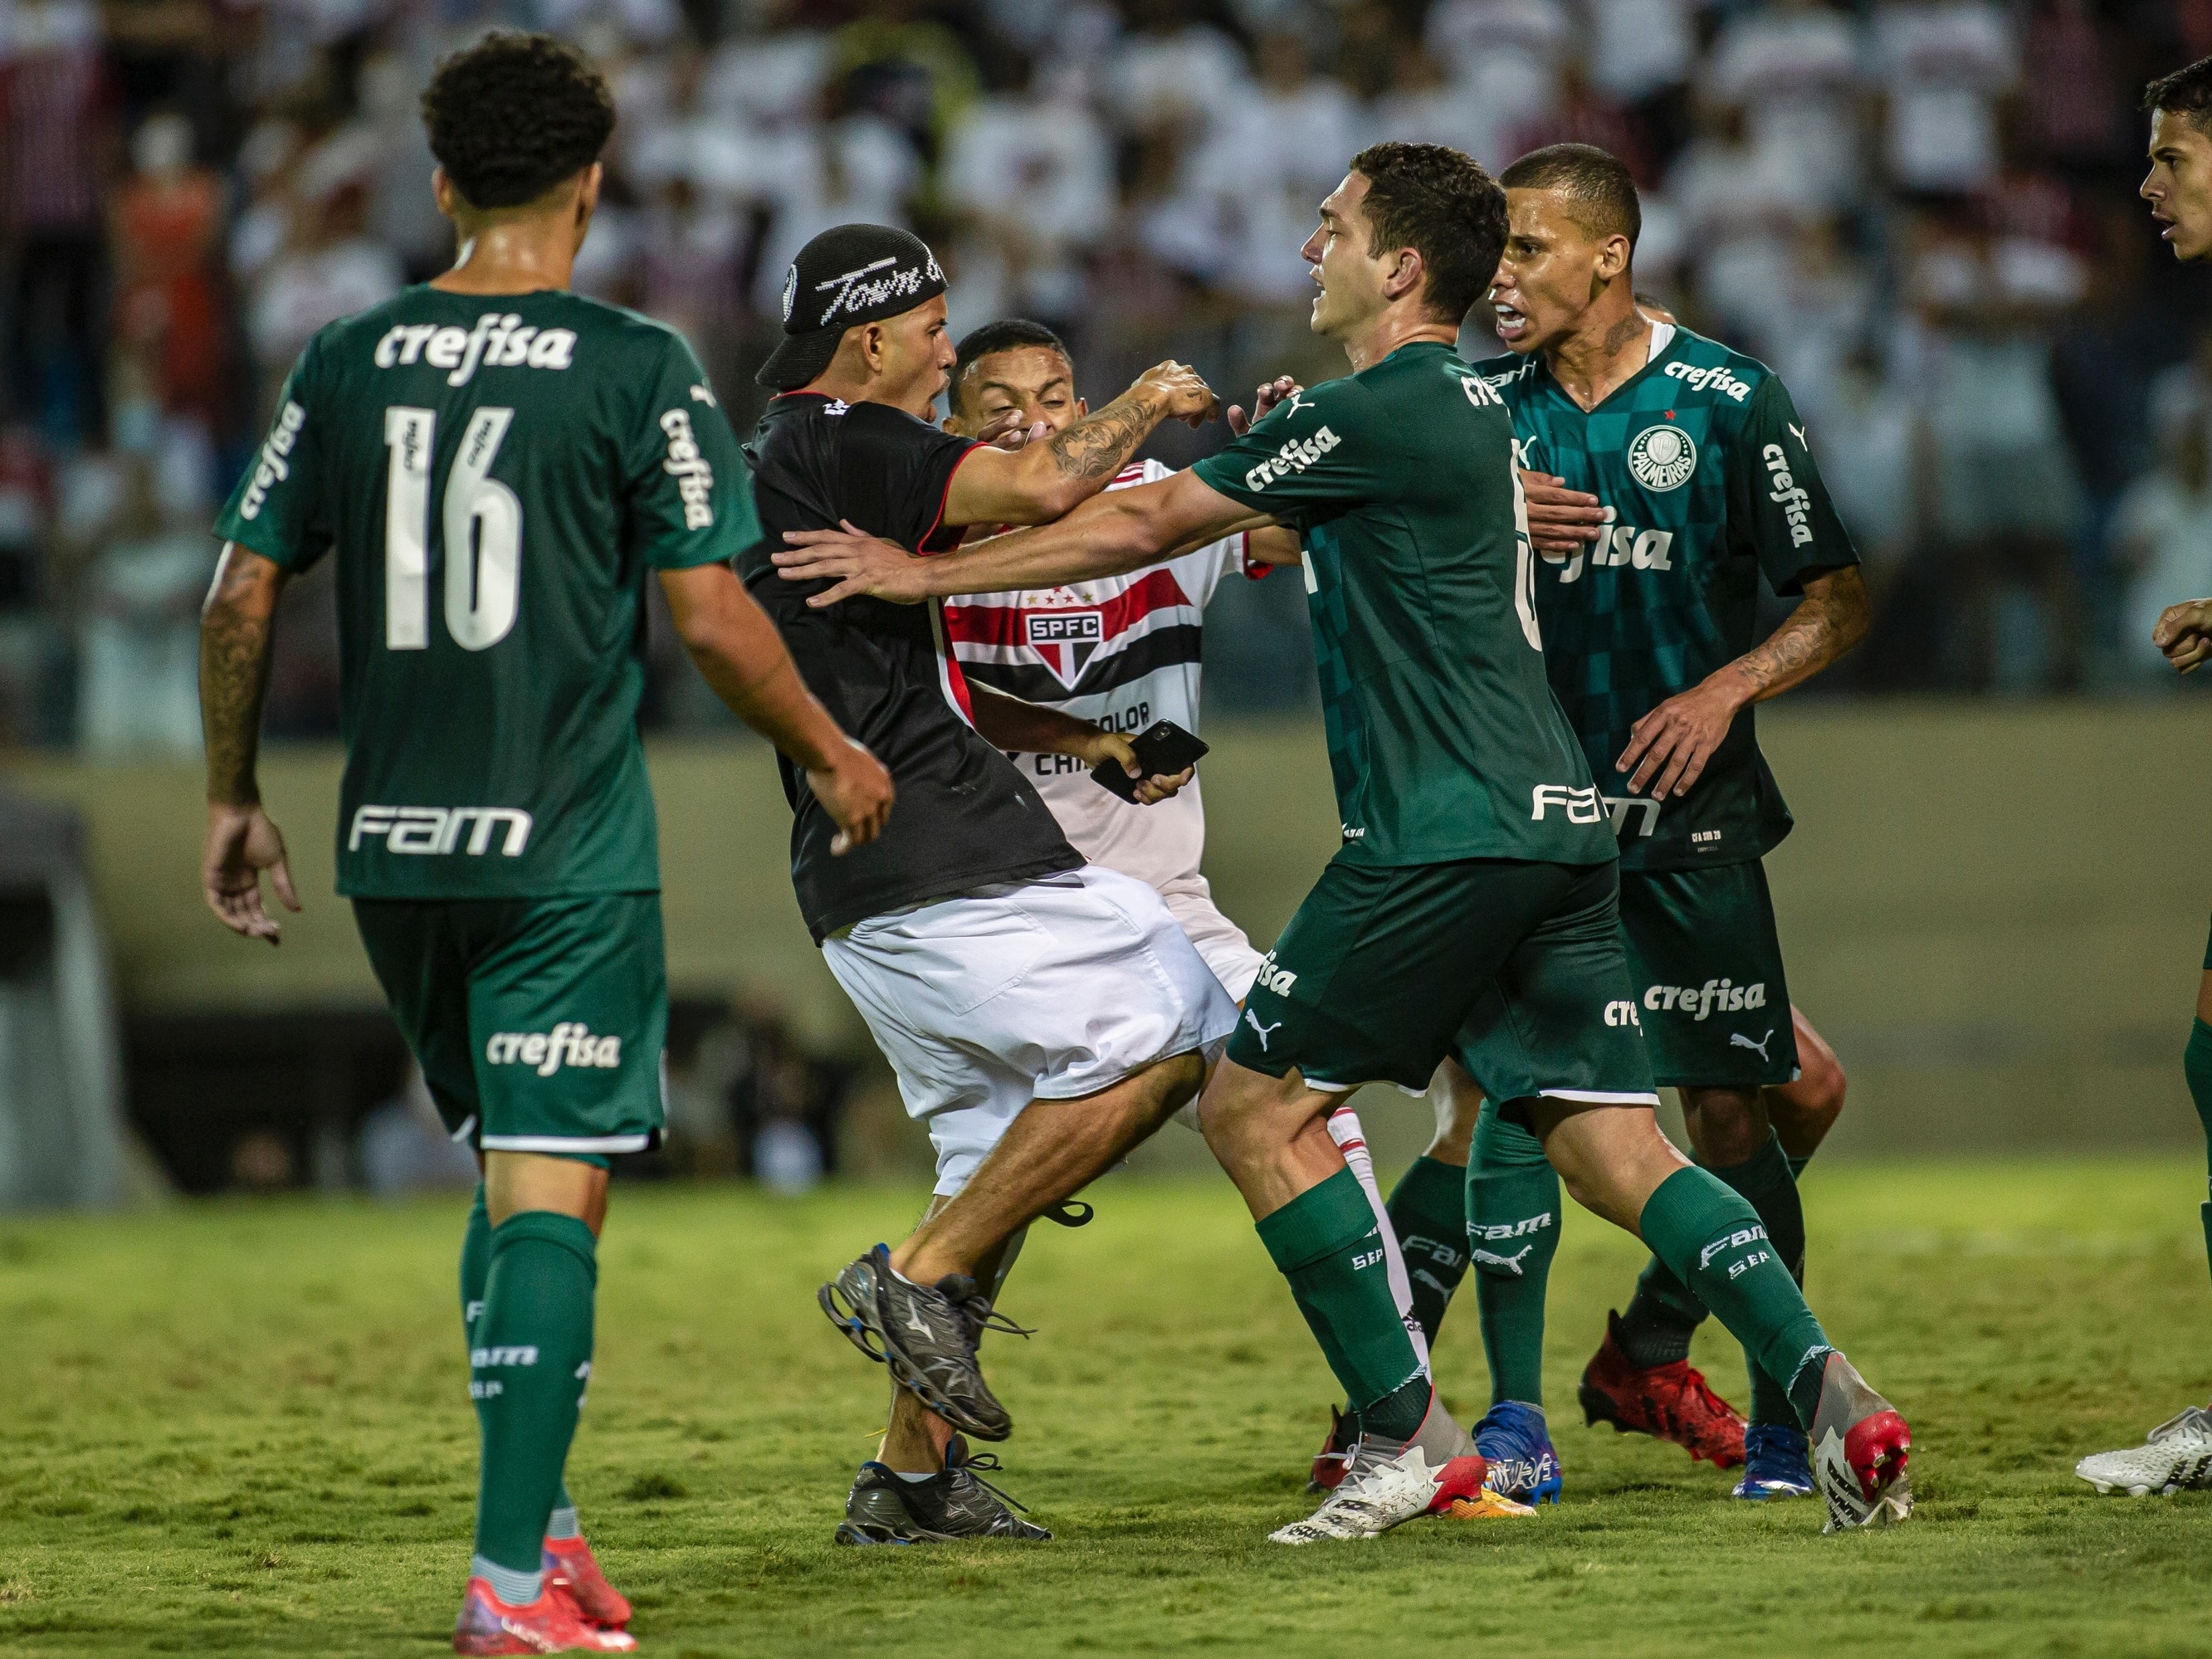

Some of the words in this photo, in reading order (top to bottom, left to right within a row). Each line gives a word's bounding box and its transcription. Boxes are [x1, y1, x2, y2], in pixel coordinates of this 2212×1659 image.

[374, 312, 578, 388] crefisa
[1663, 360, 1751, 403] crefisa
[240, 400, 307, 521] crefisa
[659, 407, 715, 531] crefisa
[1245, 425, 1342, 492] crefisa
[1633, 451, 1692, 488] PALMEIRAS
[1762, 443, 1814, 549] crefisa
[384, 406, 523, 651] 16
[1032, 617, 1099, 638] SPFC
[347, 804, 534, 857] Fam
[1643, 978, 1767, 1022] crefisa
[486, 1022, 623, 1077] crefisa
[1351, 1248, 1384, 1271] SEP
[1727, 1251, 1770, 1280] SEP
